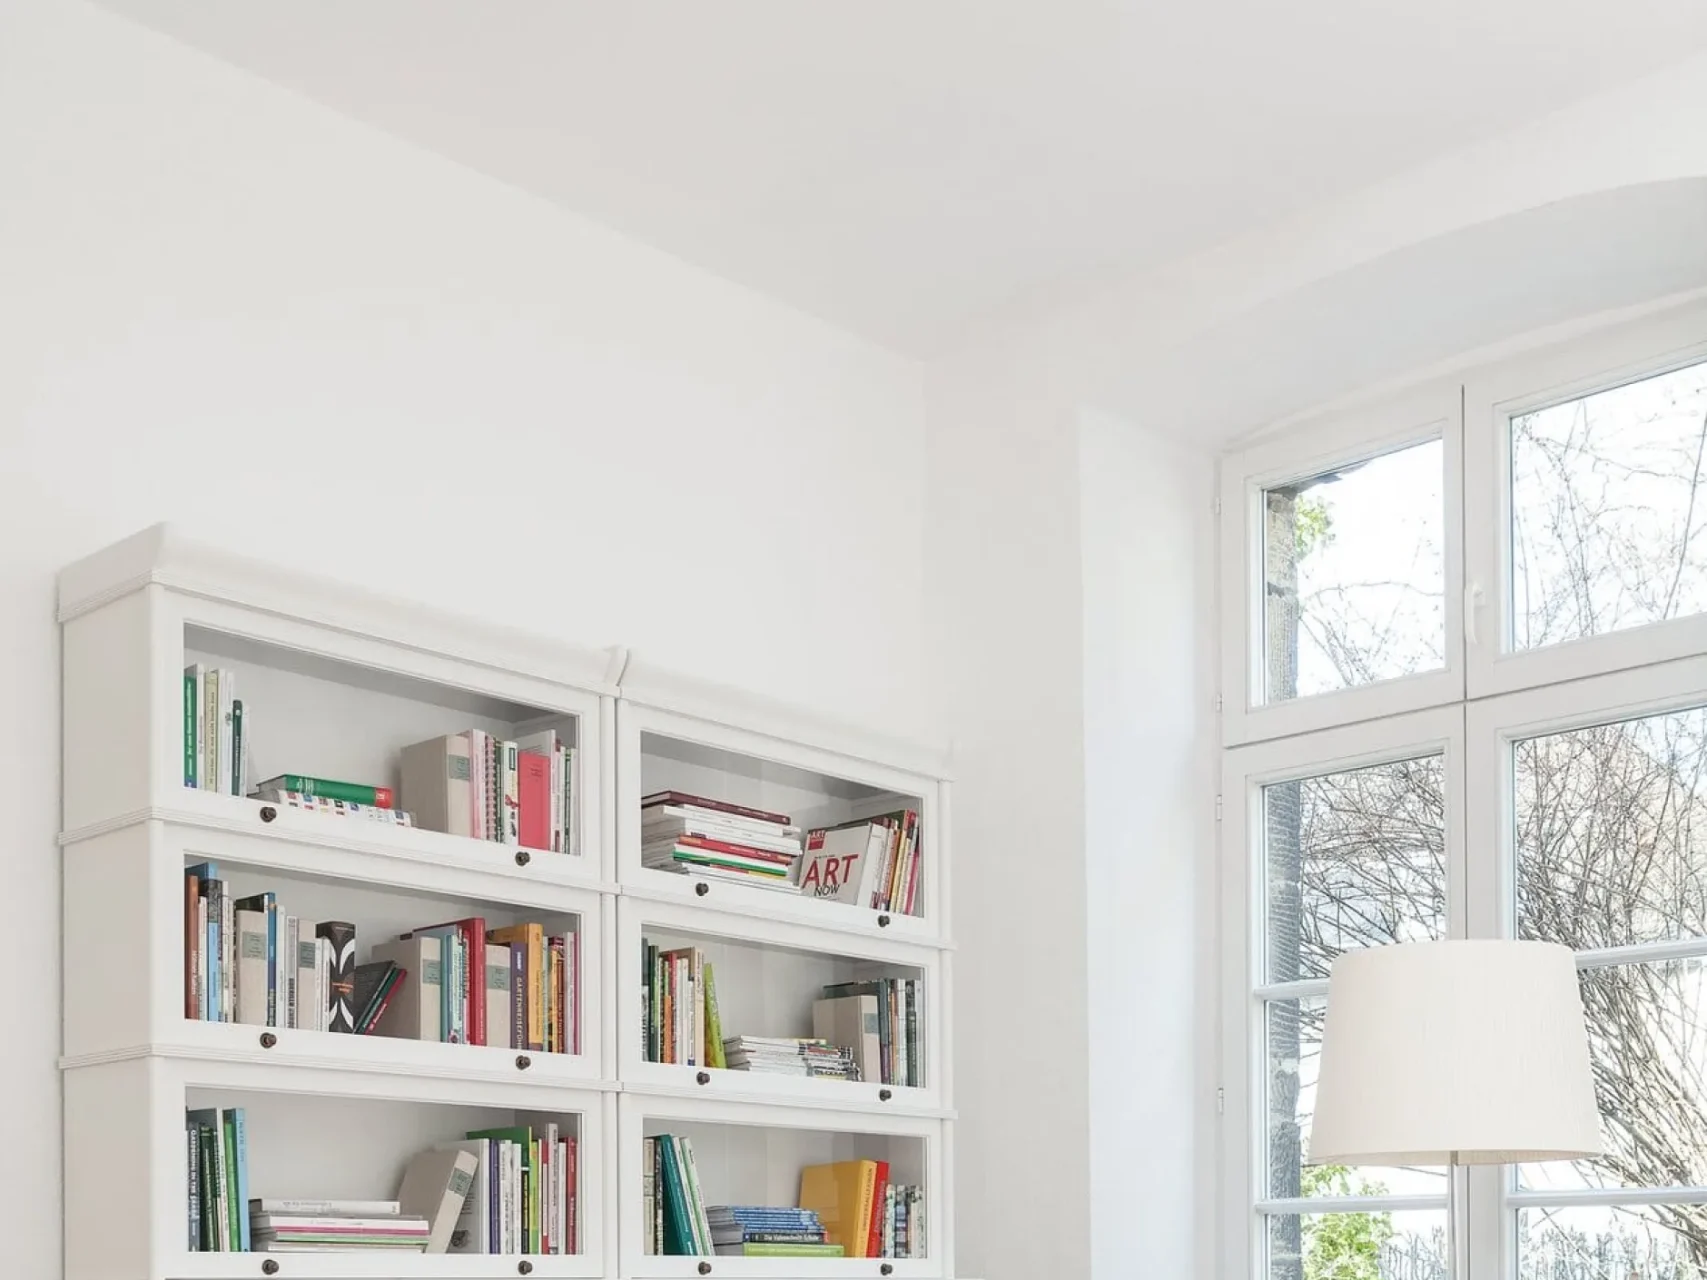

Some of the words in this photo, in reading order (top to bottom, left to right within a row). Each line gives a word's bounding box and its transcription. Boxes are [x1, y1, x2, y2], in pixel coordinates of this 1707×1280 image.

[803, 854, 858, 889] ART
[814, 883, 841, 897] NOW
[516, 975, 524, 1049] GARTENREISEFÜH
